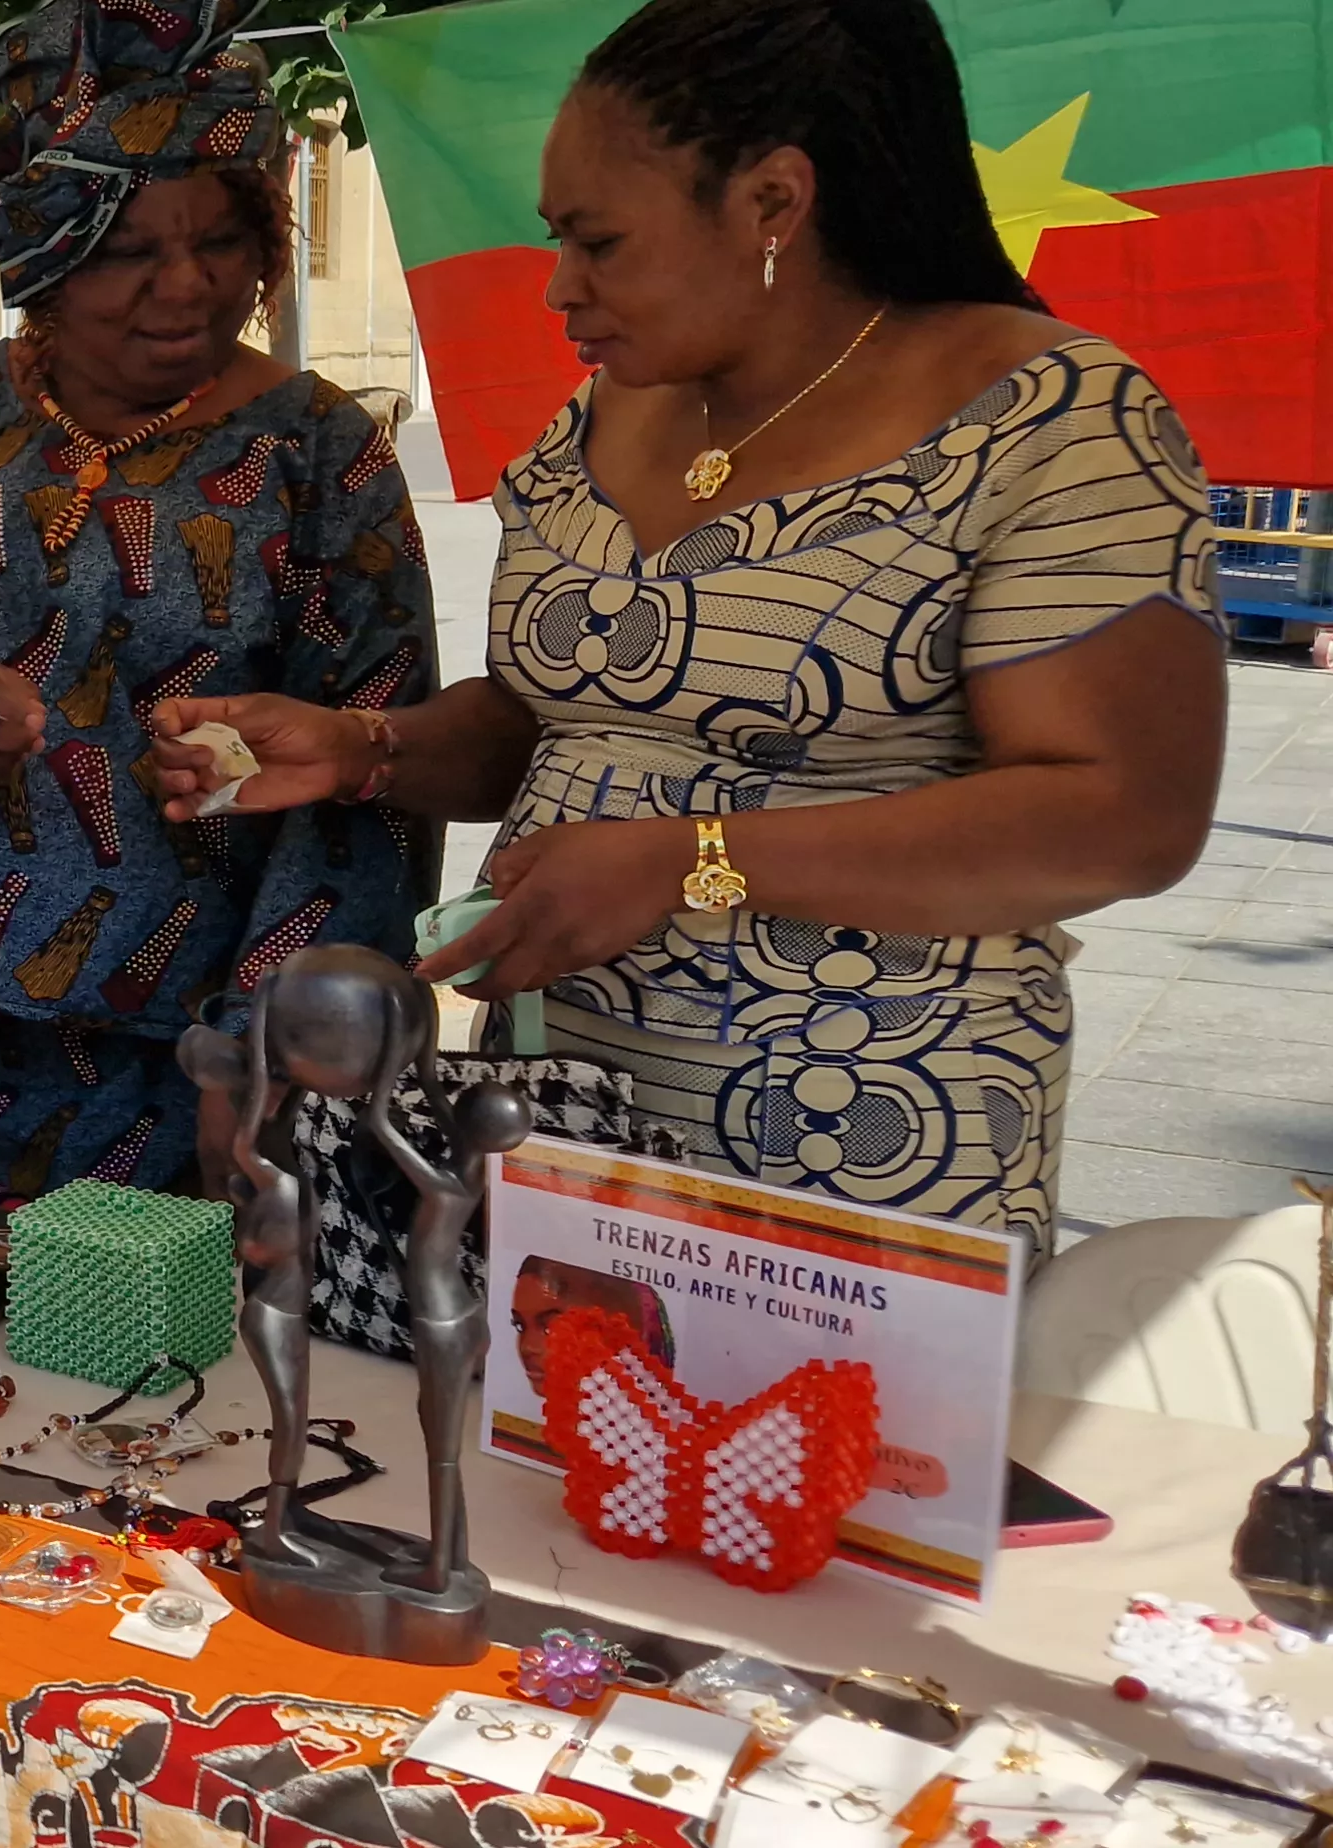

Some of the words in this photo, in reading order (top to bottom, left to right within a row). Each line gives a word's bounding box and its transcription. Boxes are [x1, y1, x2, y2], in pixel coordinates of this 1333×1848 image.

[592, 1217, 712, 1268] TRENZAS
[724, 1249, 888, 1312] AFRICANAS
[689, 1278, 737, 1306] ARTE
[746, 1291, 758, 1311] Y
[765, 1297, 854, 1337] CULTURA
